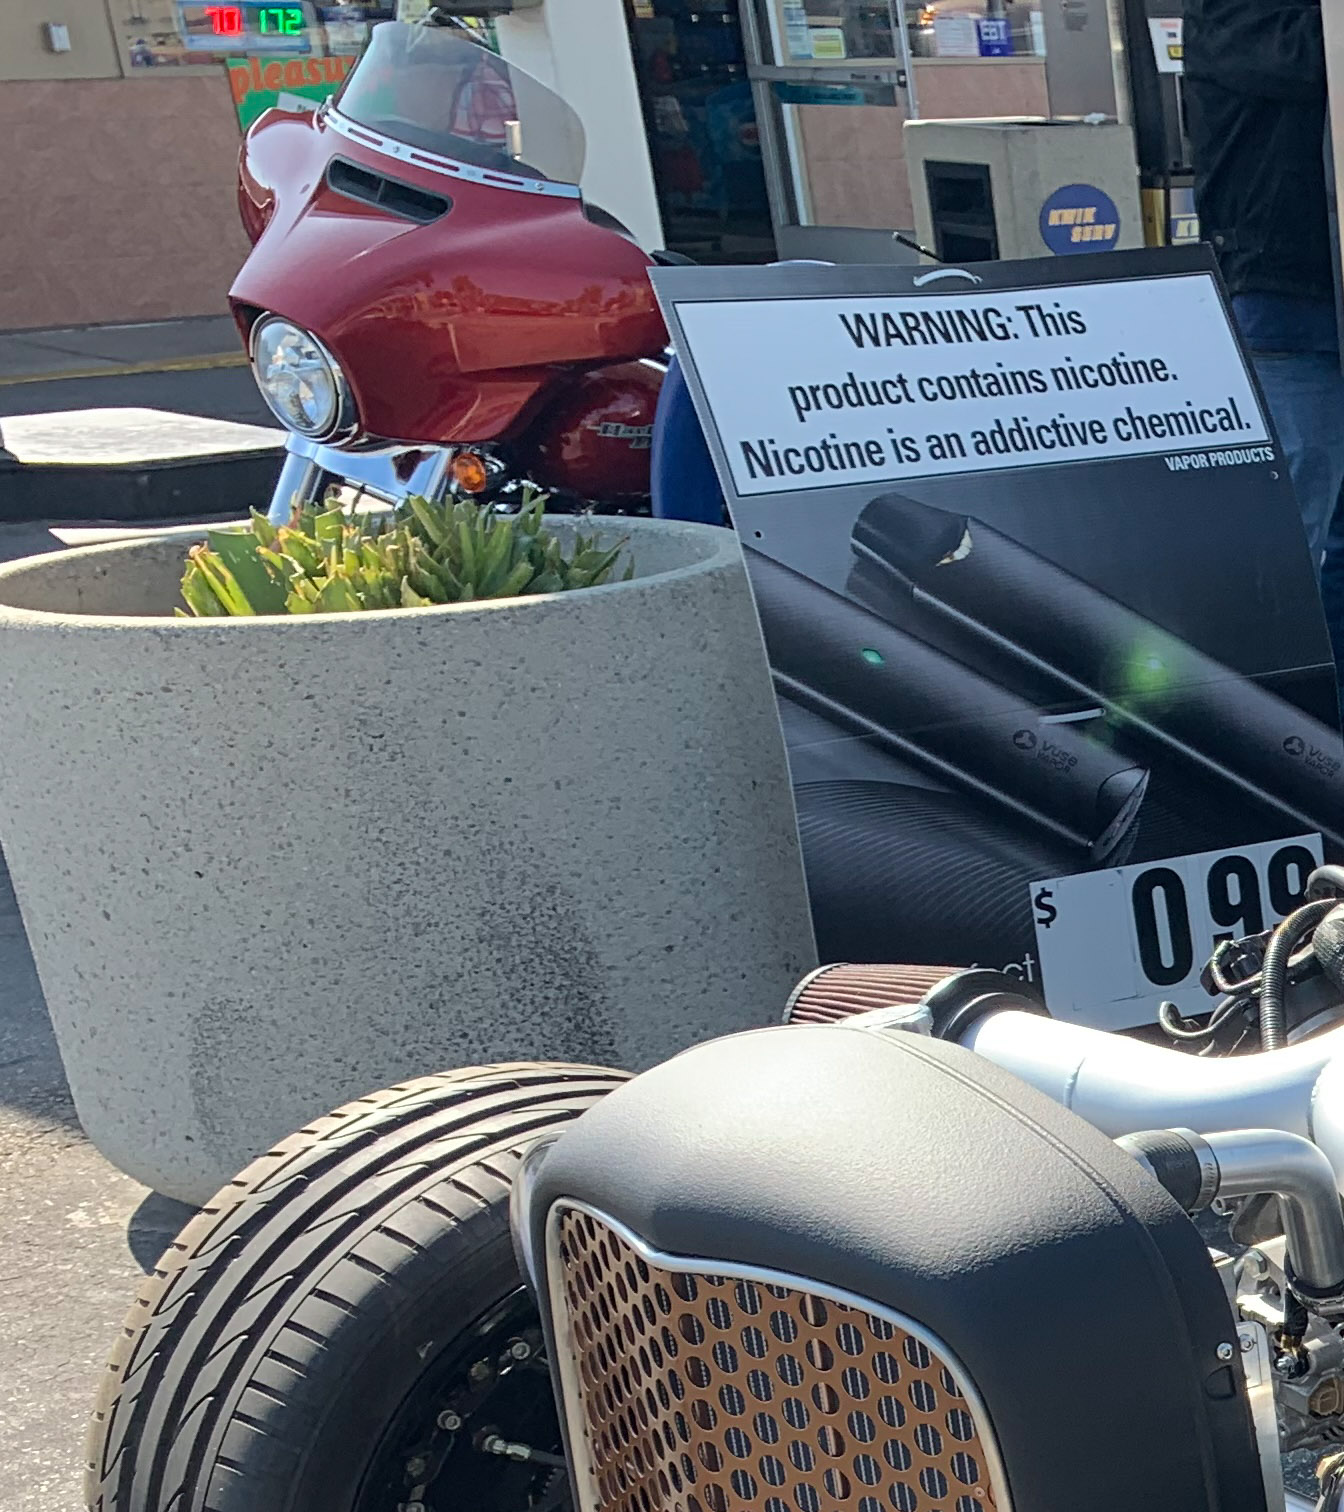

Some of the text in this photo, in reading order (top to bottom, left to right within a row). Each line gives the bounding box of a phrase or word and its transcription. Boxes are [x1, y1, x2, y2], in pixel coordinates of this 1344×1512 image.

[259, 8, 303, 36] 172
[229, 56, 352, 104] pleasu
[838, 302, 1087, 349] WARNING: This
[788, 352, 1178, 423] product contains nicotine.
[739, 397, 1251, 479] Nicotine is an addictive chemical.
[1165, 446, 1275, 472] VAPOR PRODUCTS
[1034, 886, 1057, 929] $
